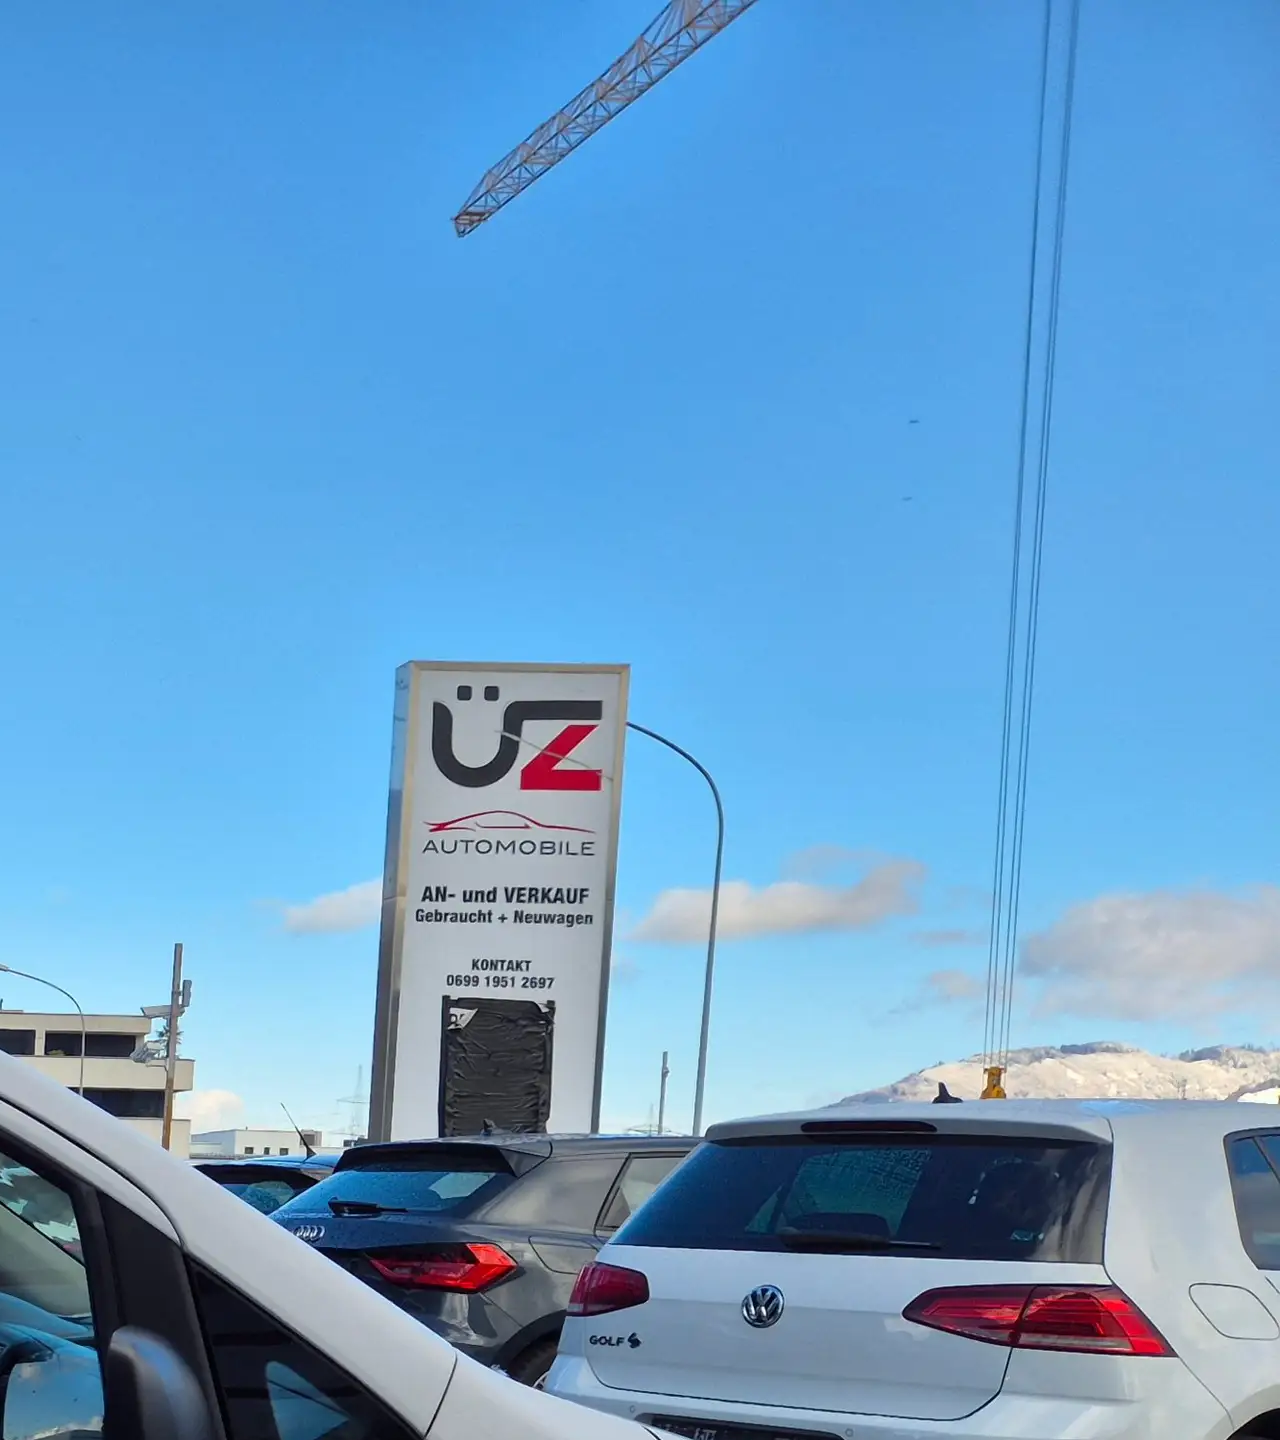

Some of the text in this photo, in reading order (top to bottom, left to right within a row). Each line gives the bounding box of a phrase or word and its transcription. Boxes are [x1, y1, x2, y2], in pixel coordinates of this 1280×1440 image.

[422, 838, 596, 856] AUTOMOBILE
[421, 886, 589, 904] AN- und VERKAUF
[415, 908, 492, 923] Gebraucht
[513, 910, 593, 928] Neuwagen
[471, 958, 532, 972] KONTAKT
[446, 974, 555, 989] 0699 1951 2697
[589, 1335, 625, 1347] GOLF
